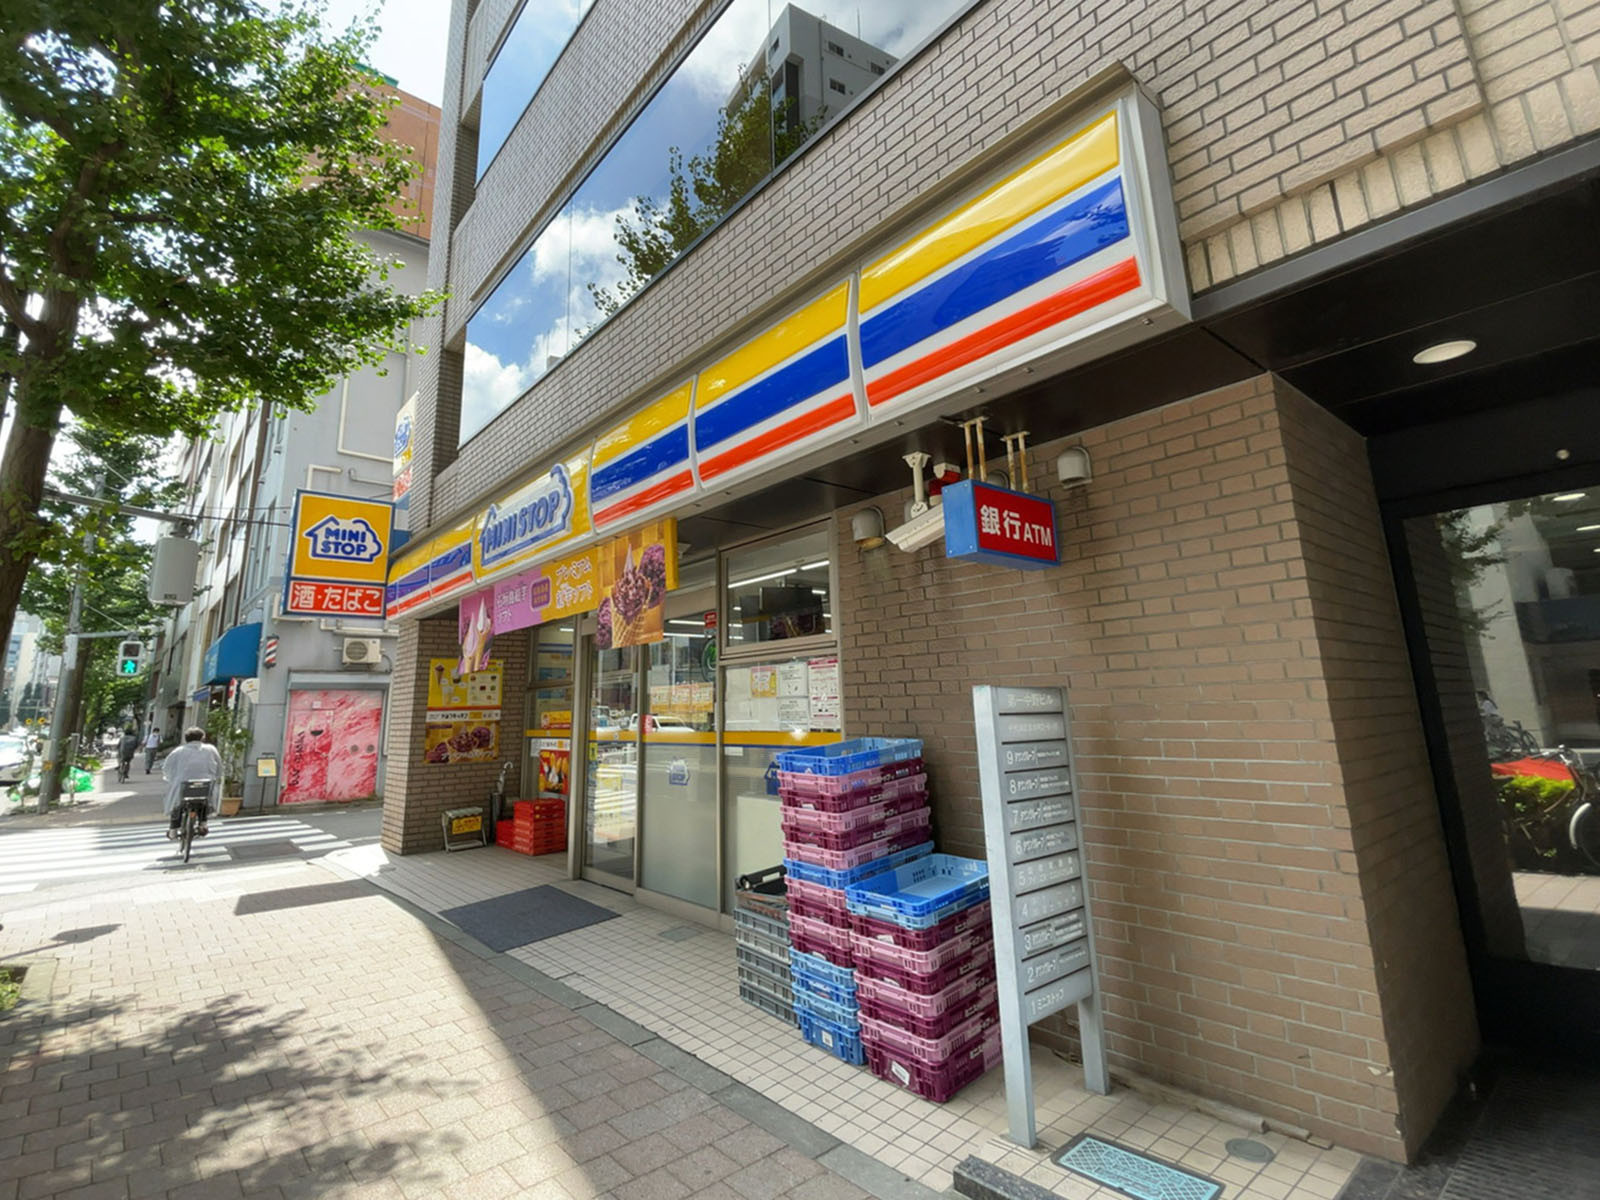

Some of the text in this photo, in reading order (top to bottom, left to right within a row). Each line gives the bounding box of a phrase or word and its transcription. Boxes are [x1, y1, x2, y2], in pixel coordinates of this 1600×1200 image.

[325, 527, 367, 543] MINI
[321, 541, 368, 556] STOP
[291, 584, 381, 612] 酒・たばこ
[1006, 750, 1014, 765] 9
[1009, 779, 1016, 794] 8
[1016, 839, 1022, 855] 6
[1024, 934, 1032, 951] 3
[1027, 966, 1034, 984] 2
